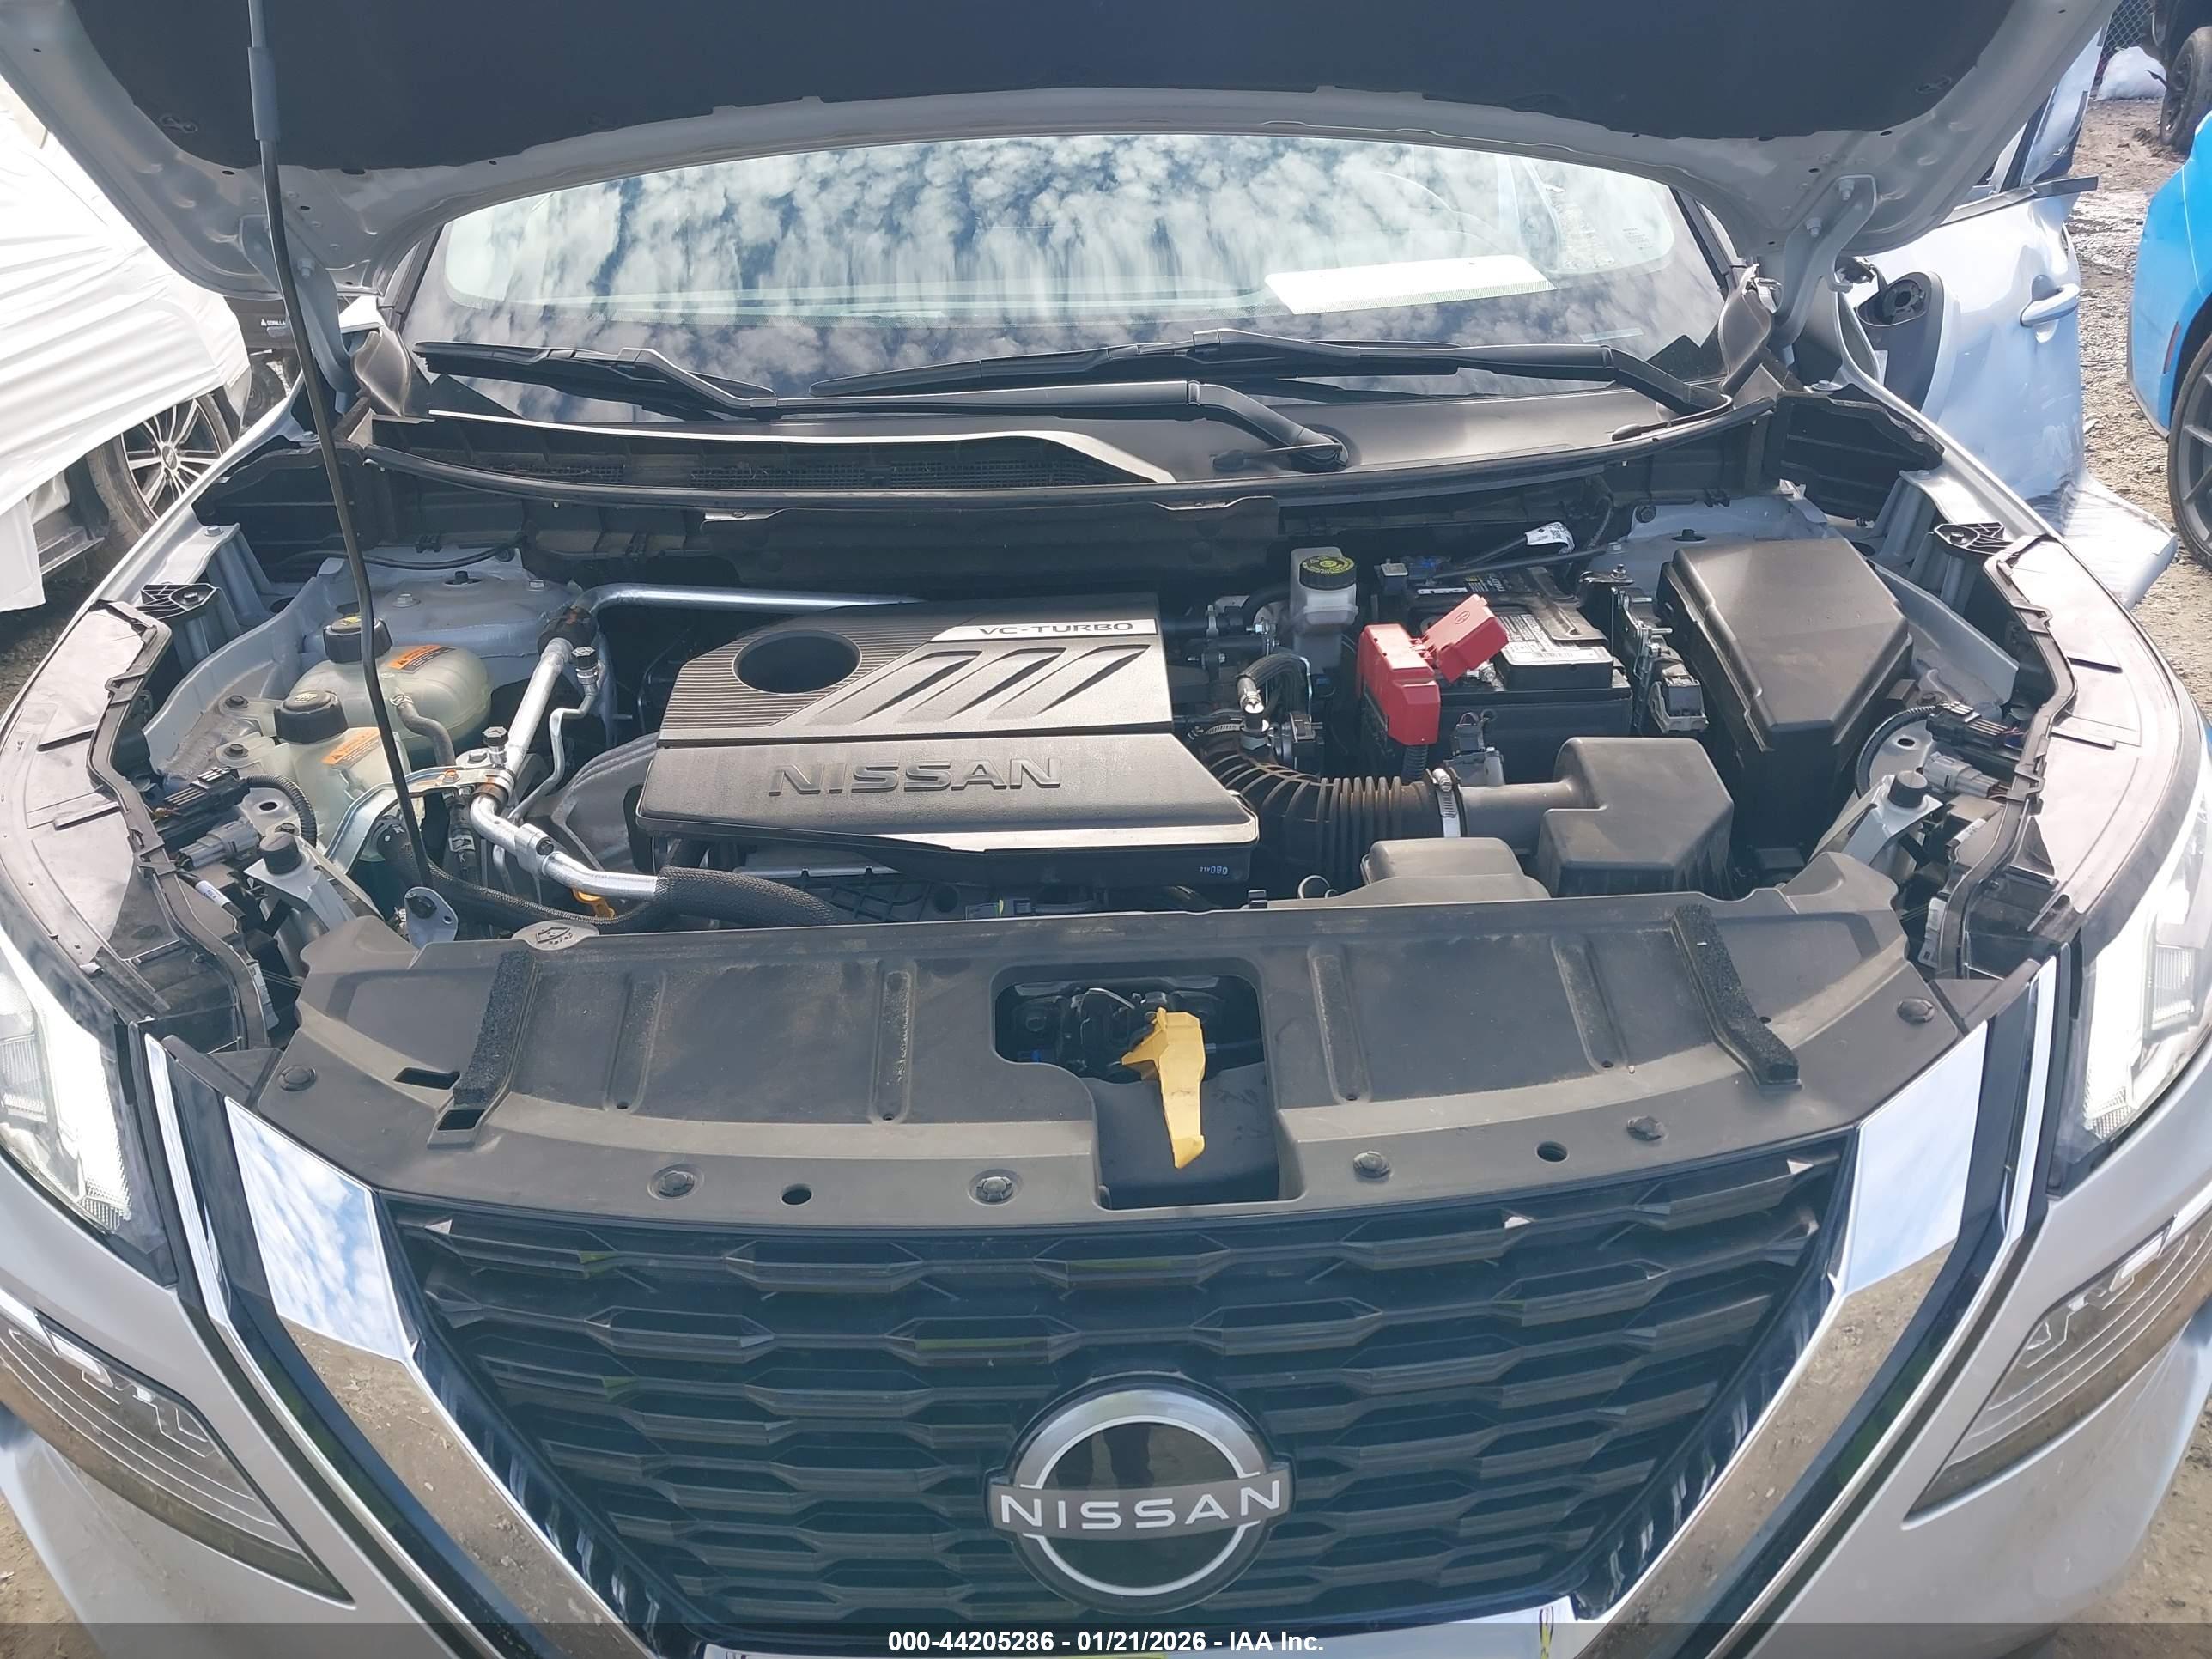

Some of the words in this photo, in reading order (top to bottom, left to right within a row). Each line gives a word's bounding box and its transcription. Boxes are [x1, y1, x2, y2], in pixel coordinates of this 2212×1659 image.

[978, 622, 1133, 635] VC-TURBO
[769, 756, 1062, 797] NISSAN
[1000, 1480, 1280, 1530] NISSAN
